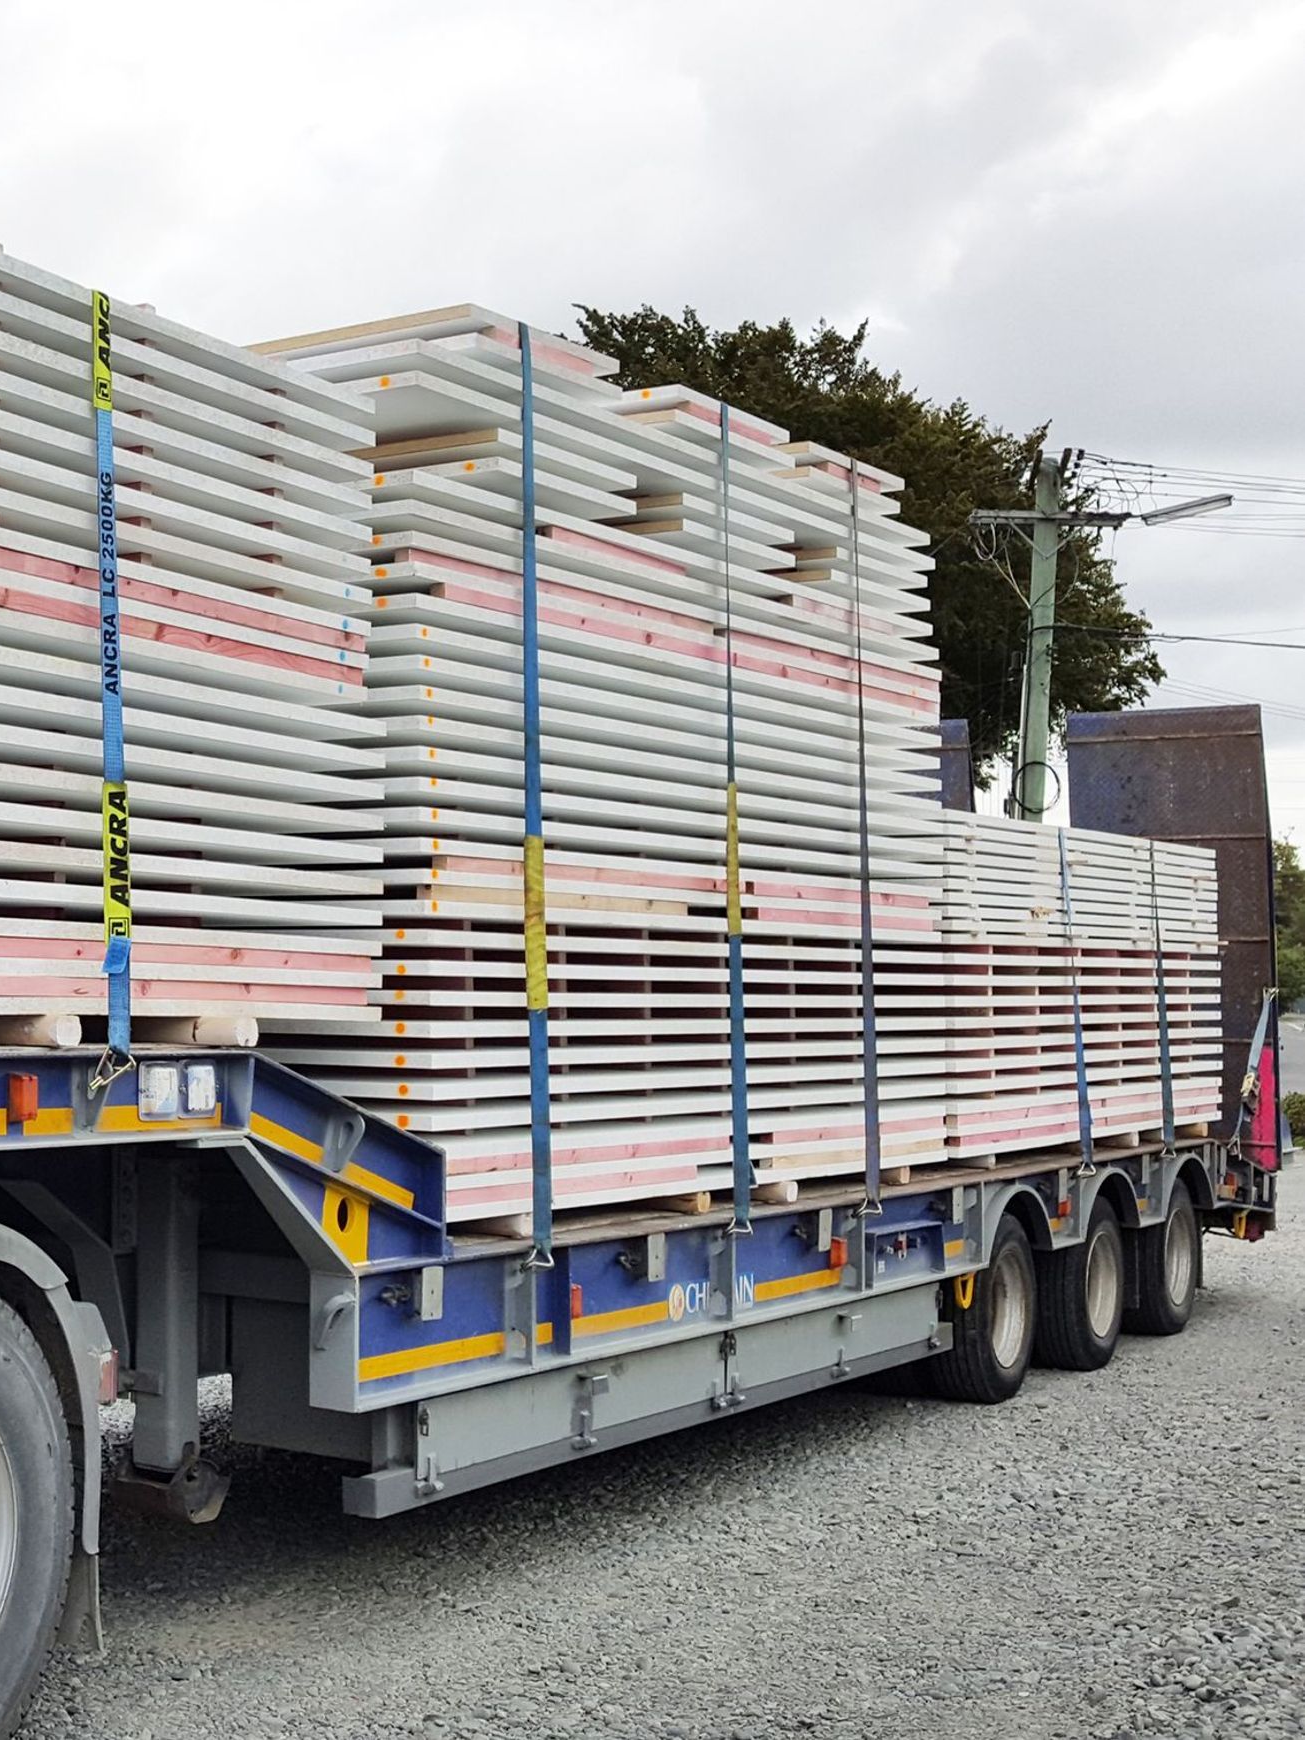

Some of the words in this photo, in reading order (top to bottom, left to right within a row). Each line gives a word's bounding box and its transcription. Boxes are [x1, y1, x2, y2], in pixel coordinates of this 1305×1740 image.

[98, 291, 111, 371] ANC
[100, 472, 115, 559] 2500KG
[102, 568, 116, 598] LC
[103, 614, 119, 695] ANCRA
[109, 791, 130, 908] ANCRA
